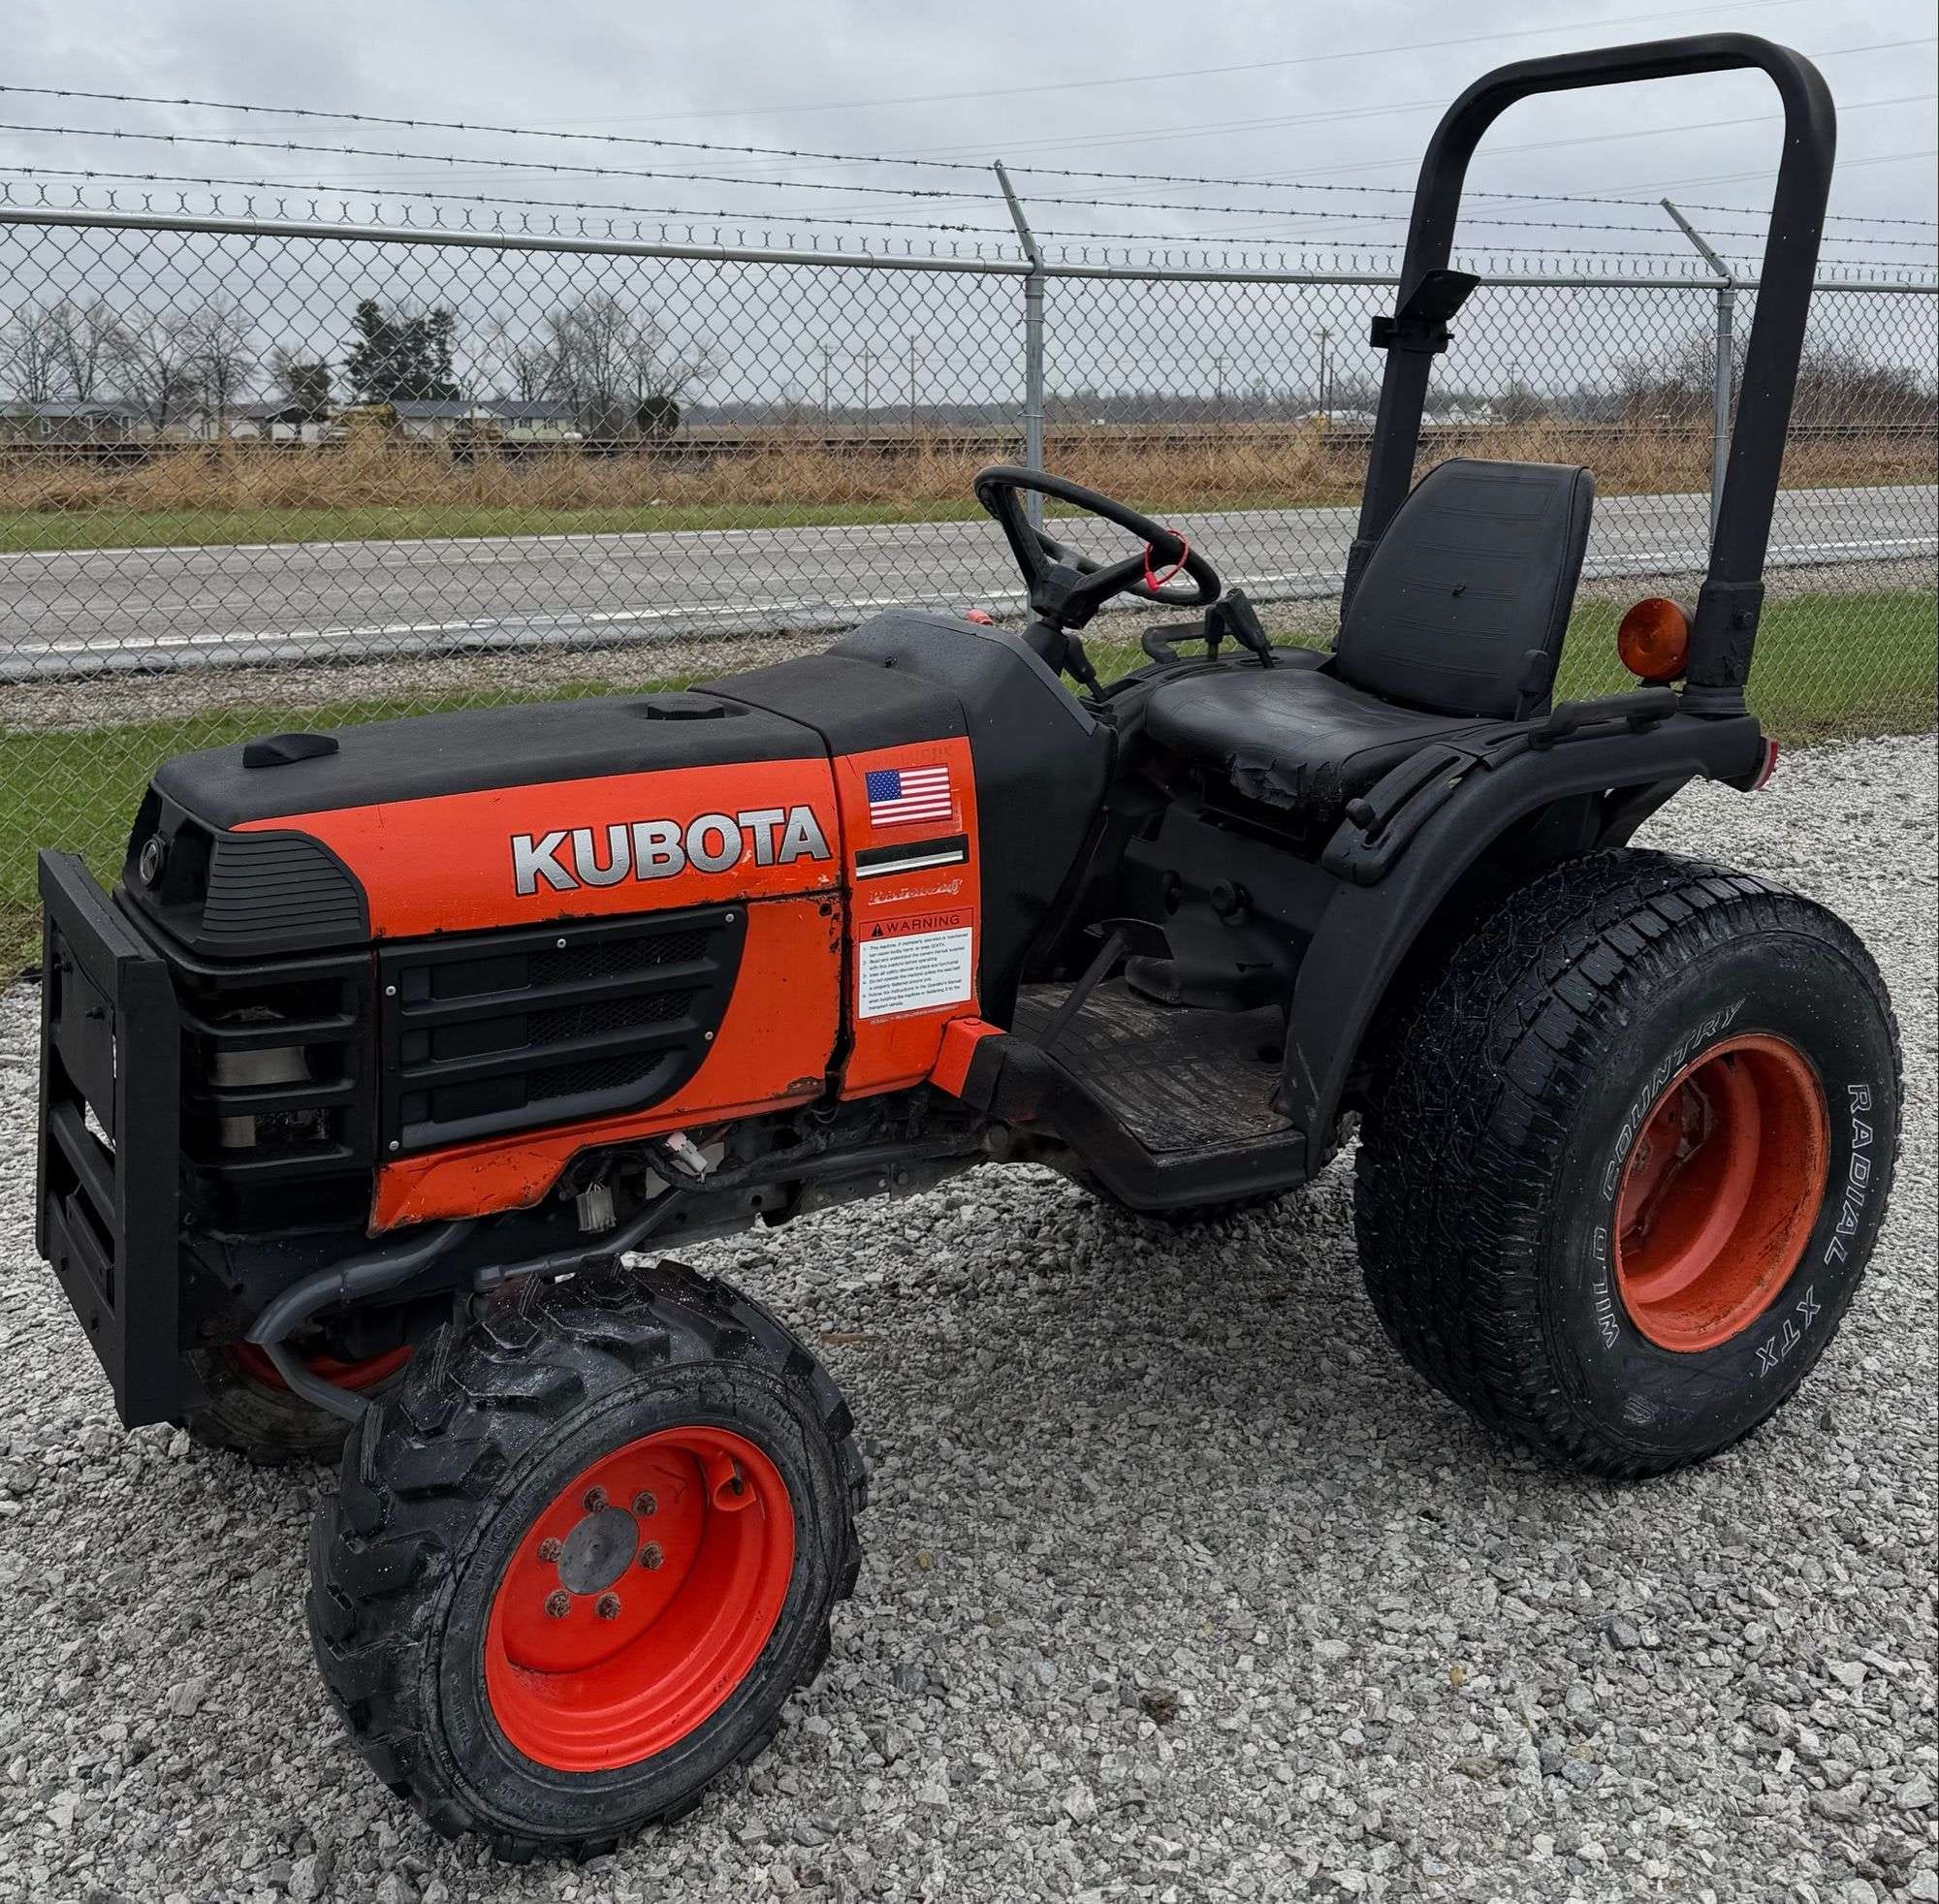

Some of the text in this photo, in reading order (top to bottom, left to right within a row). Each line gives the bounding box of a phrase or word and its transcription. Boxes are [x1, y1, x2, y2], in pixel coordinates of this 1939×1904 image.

[510, 805, 832, 896] KUBOTA
[886, 914, 961, 934] WARNING
[1593, 998, 1747, 1349] WILD COUNTRY
[1756, 1084, 1874, 1378] RADIAL XTX
